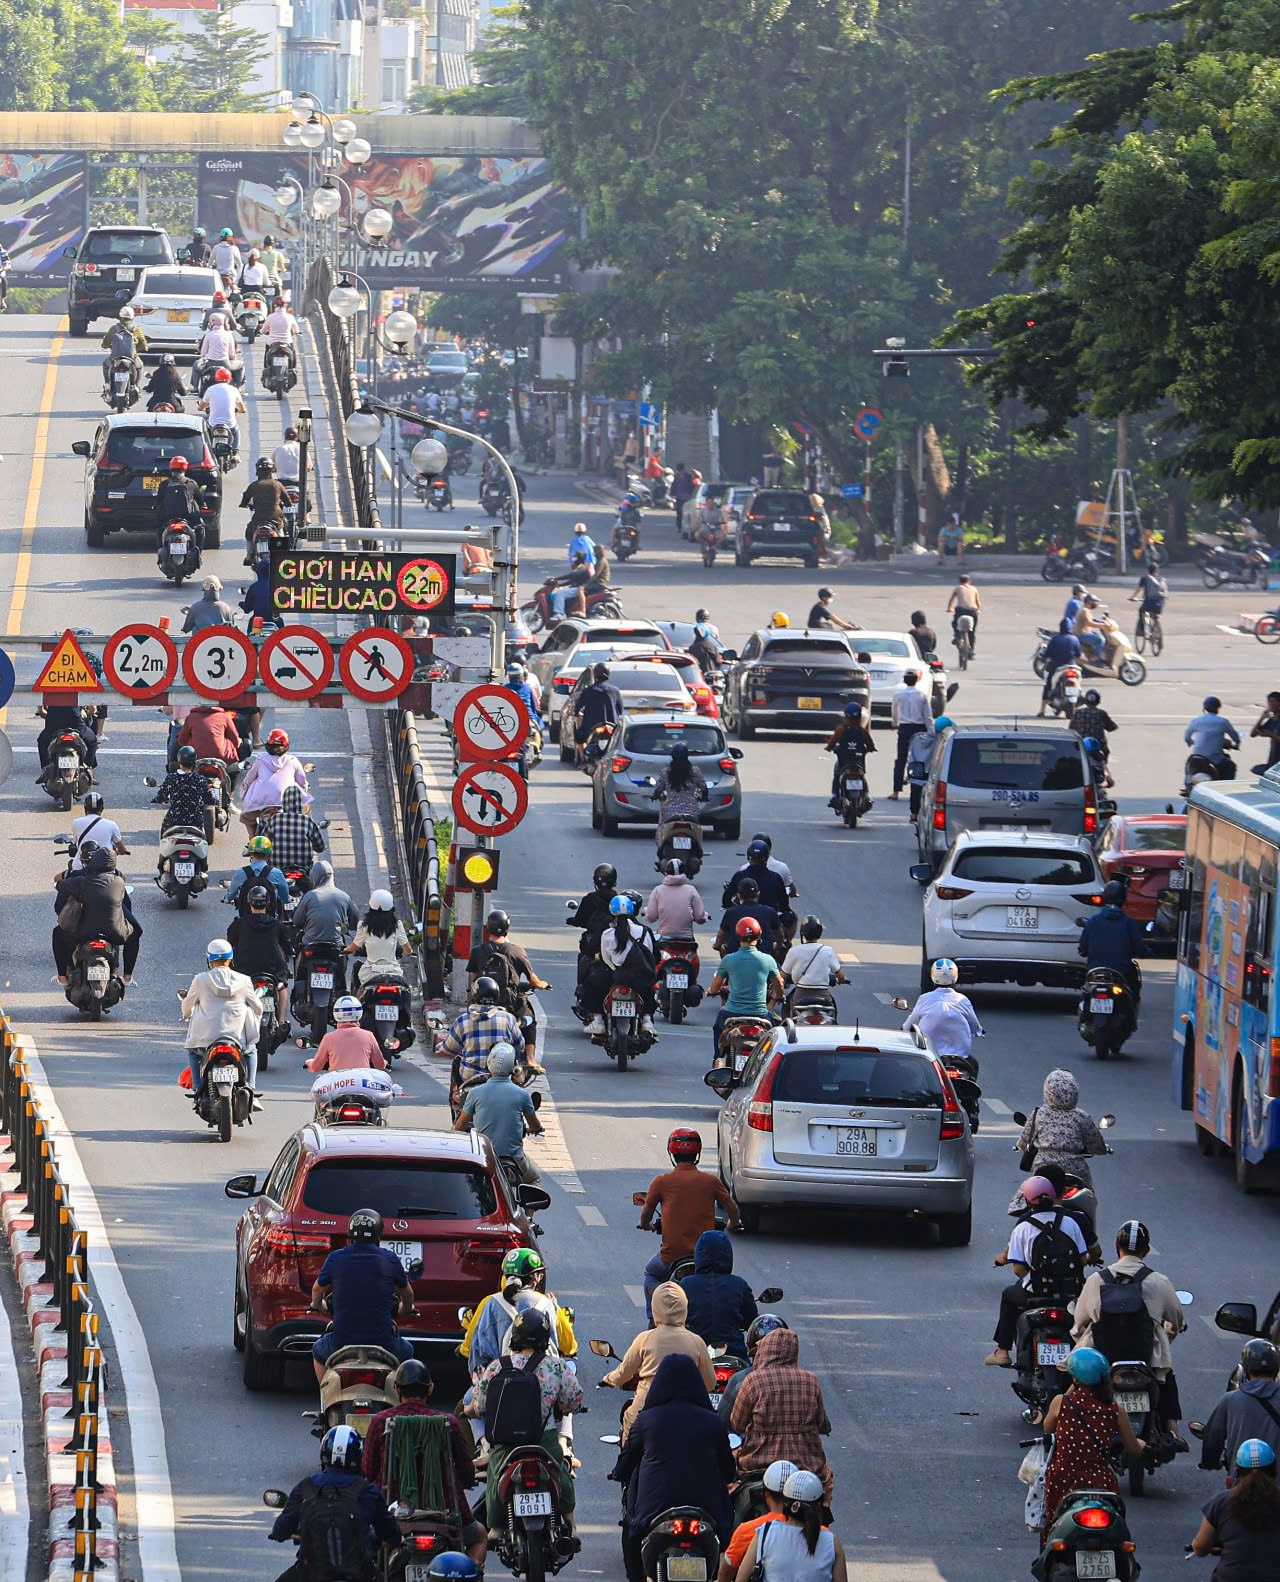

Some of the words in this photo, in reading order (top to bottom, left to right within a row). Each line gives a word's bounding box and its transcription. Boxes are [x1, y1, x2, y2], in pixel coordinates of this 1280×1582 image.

[370, 250, 440, 267] NGAY
[278, 557, 328, 582] GIỚI
[340, 561, 393, 587] HẠN
[60, 653, 78, 669] ĐI
[47, 668, 88, 687] CHẬM
[1013, 906, 1031, 918] 97A
[317, 1084, 333, 1096] NEW
[333, 1077, 356, 1090] HOPE
[846, 1128, 867, 1141] 29A
[838, 1140, 875, 1155] 908.88
[388, 1241, 412, 1256] 30E
[519, 1493, 546, 1505] 29-X1
[519, 1504, 547, 1516] 8091
[1082, 1563, 1111, 1577] 2750
